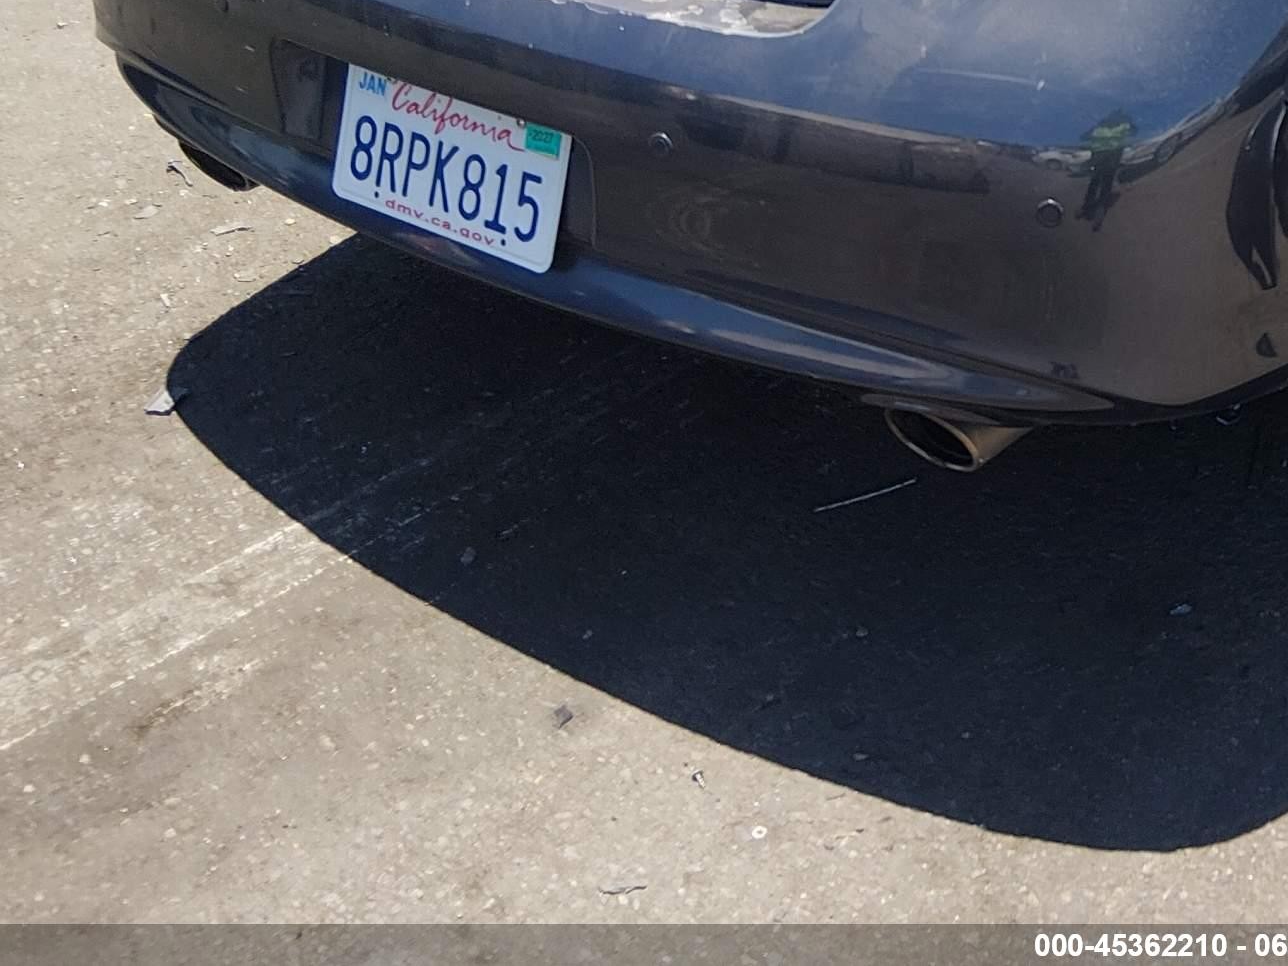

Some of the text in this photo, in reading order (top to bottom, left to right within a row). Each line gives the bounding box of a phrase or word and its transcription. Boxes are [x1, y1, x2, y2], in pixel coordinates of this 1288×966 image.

[358, 71, 387, 97] JAN
[390, 80, 525, 152] California
[349, 114, 544, 243] 8RPK815
[384, 197, 495, 247] dmv.ca.gov
